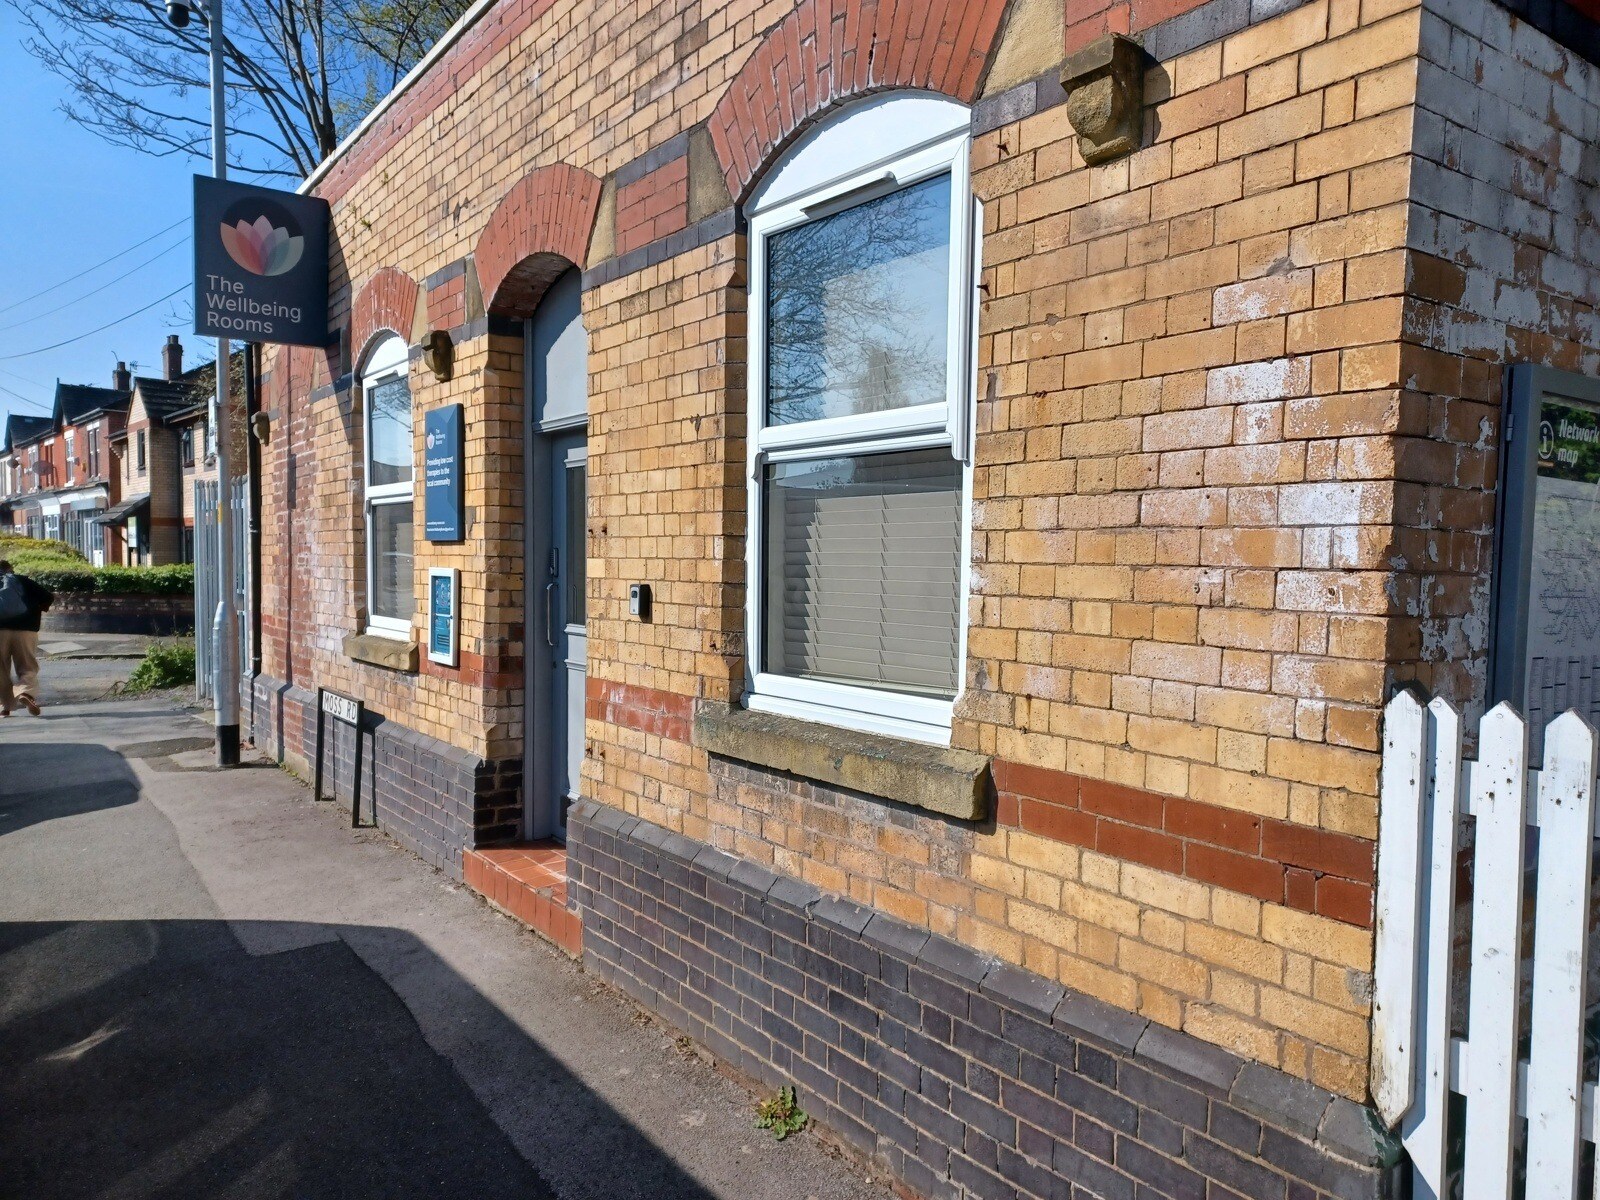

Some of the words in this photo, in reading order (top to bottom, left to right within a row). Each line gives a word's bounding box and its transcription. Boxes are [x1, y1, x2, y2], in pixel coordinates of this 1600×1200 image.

[206, 274, 244, 294] The
[206, 293, 301, 323] Wellbeing
[207, 311, 273, 334] Rooms
[1559, 418, 1600, 443] Network
[1557, 448, 1579, 468] map
[324, 692, 342, 715] MOSS
[347, 701, 356, 720] RD
